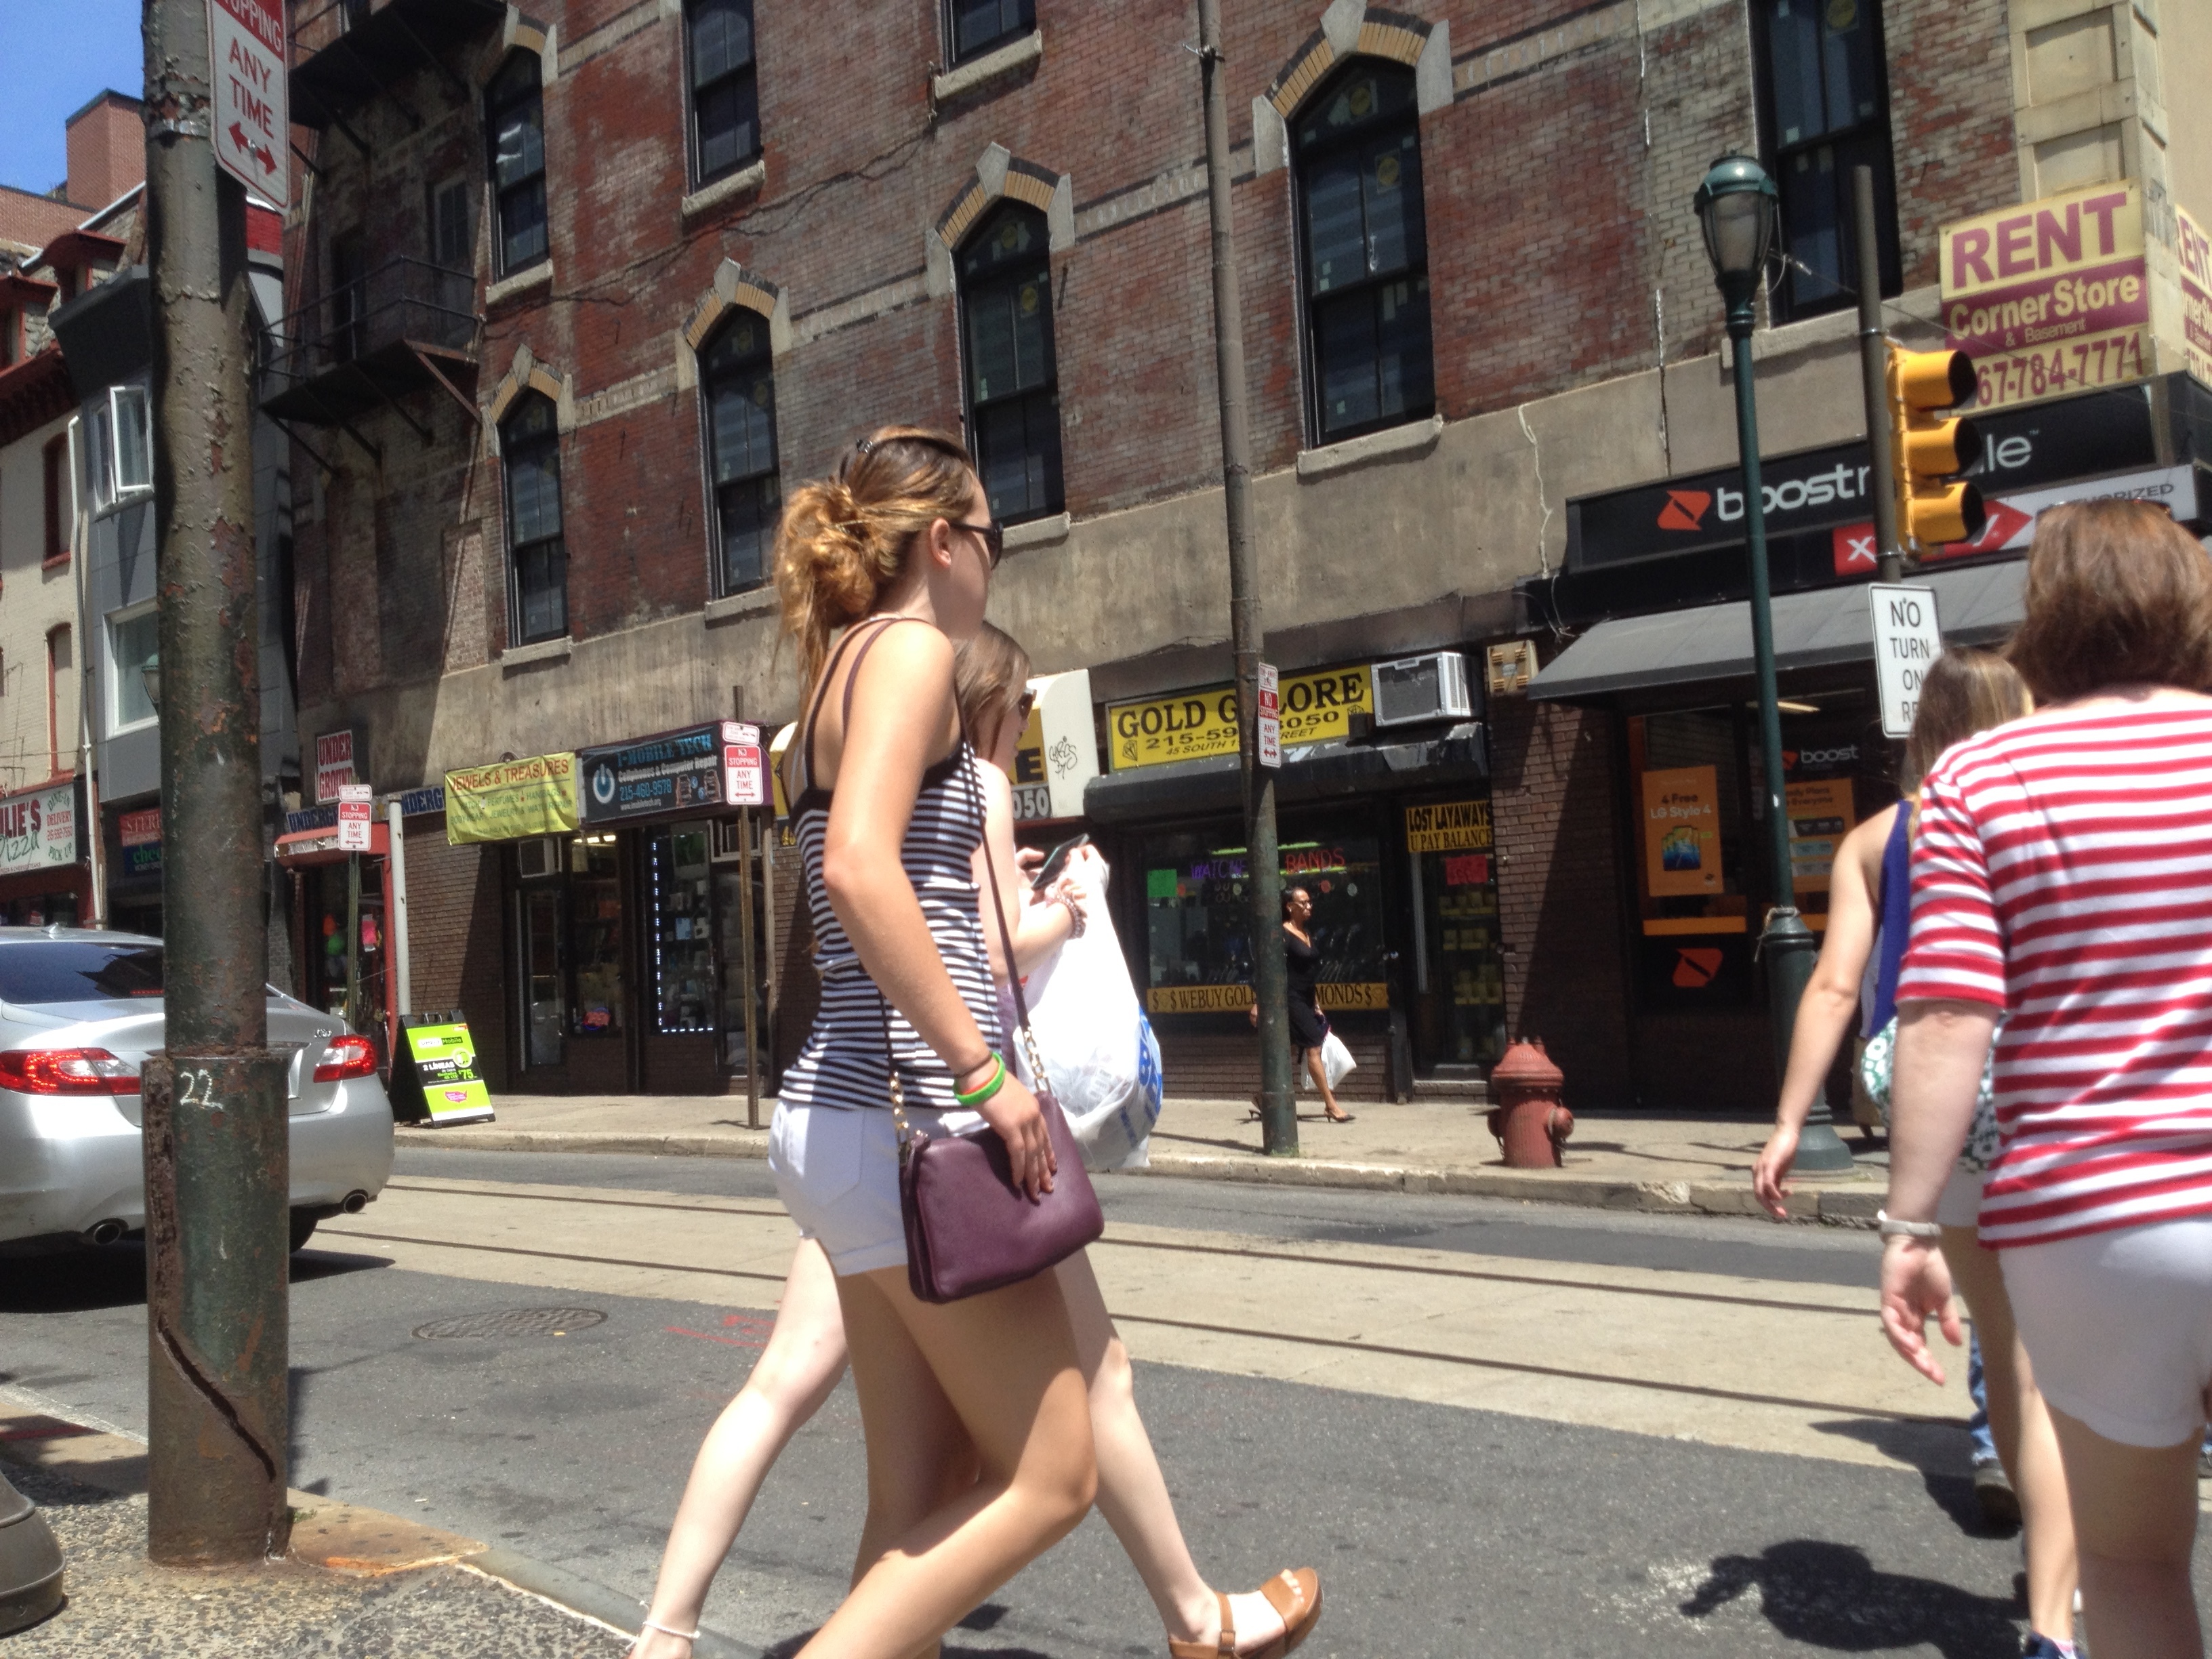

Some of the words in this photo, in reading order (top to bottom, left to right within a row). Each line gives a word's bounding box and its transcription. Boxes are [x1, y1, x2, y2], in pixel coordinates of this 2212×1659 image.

[225, 0, 282, 52] OPPING
[229, 37, 271, 94] ANY
[229, 74, 274, 139] TIME
[1952, 192, 2127, 290] RENT
[2177, 216, 2212, 290] ENT
[1950, 291, 2051, 340] Corner
[2053, 274, 2139, 316] Store
[2025, 317, 2086, 343] Basement
[1890, 600, 1921, 628] NO
[1889, 637, 1930, 659] TURN
[1902, 669, 1924, 691] ON
[1118, 699, 1206, 739] GOLD
[1218, 672, 1364, 724] GORE
[1264, 692, 1272, 708] NO
[1901, 700, 1918, 722] RE
[1259, 707, 1279, 719] STOPPING
[1183, 741, 1226, 754] SOUTH
[1279, 726, 1317, 740] REET
[1264, 724, 1275, 734] ANY
[318, 732, 352, 766] UNDER
[674, 733, 712, 756] TECH
[1264, 735, 1276, 746] TIME
[729, 757, 758, 766] STOPPING
[738, 748, 747, 756] NO
[1800, 744, 1860, 764] boost
[451, 772, 491, 792] JEWELS
[495, 770, 501, 784] &
[504, 758, 569, 783] TREASURES
[661, 759, 694, 775] Computer
[695, 754, 718, 769] Repair
[737, 769, 752, 779] ANY
[736, 780, 754, 790] TIME
[350, 804, 359, 812] NO
[1671, 793, 1698, 804] Free
[47, 811, 72, 826] DELIVERY
[342, 811, 368, 819] STOPPING
[1408, 807, 1433, 832] LOST
[1435, 801, 1492, 830] LAYAWAYS
[1650, 806, 1668, 819] LG
[347, 830, 363, 839] TIME
[348, 822, 362, 830] ANY
[1410, 834, 1418, 851] U
[1420, 833, 1441, 850] PAY
[1443, 828, 1492, 848] BALANCE
[48, 845, 63, 861] PICK
[64, 842, 73, 858] UP
[1284, 848, 1346, 874] BANDS
[1315, 984, 1364, 1005] MONDS
[180, 1068, 224, 1110] 22
